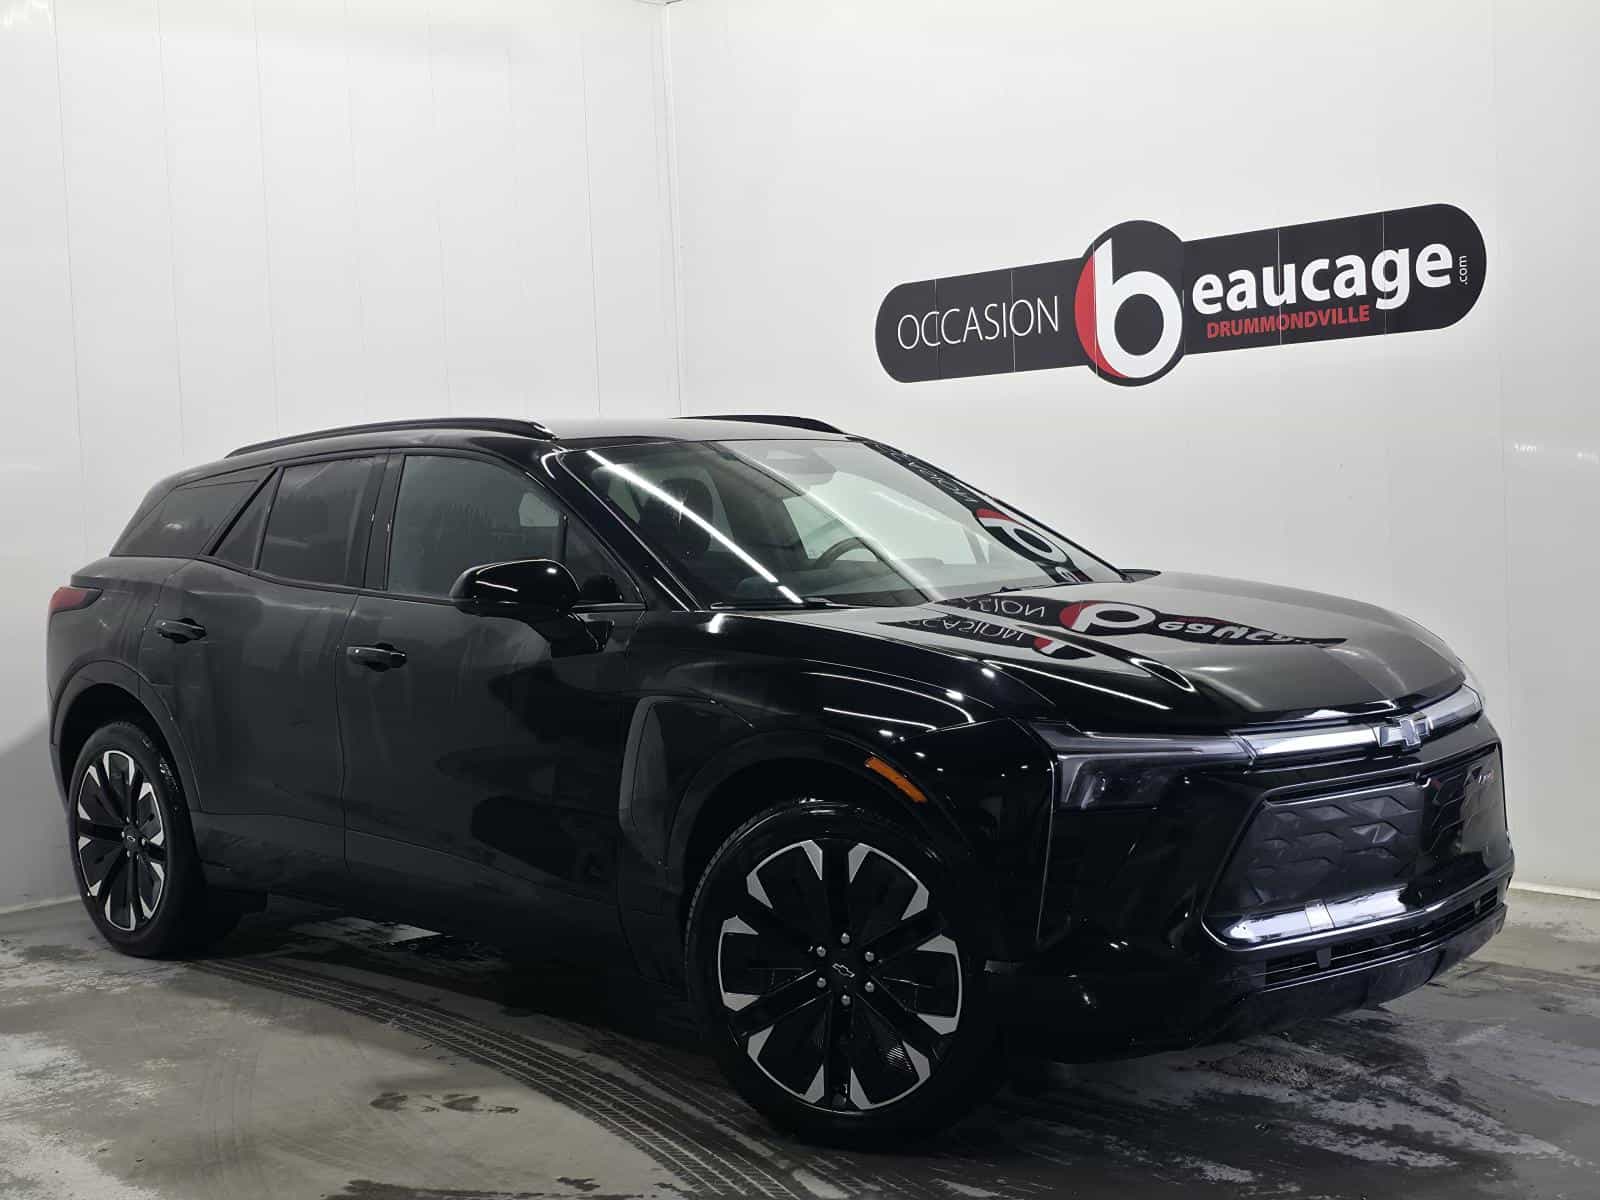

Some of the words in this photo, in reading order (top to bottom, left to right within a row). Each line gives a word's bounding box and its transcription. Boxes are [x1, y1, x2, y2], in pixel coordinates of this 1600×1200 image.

[1458, 254, 1468, 286] .com
[897, 295, 1059, 350] OCCASION
[1206, 304, 1371, 339] DRUMMONDVILLE
